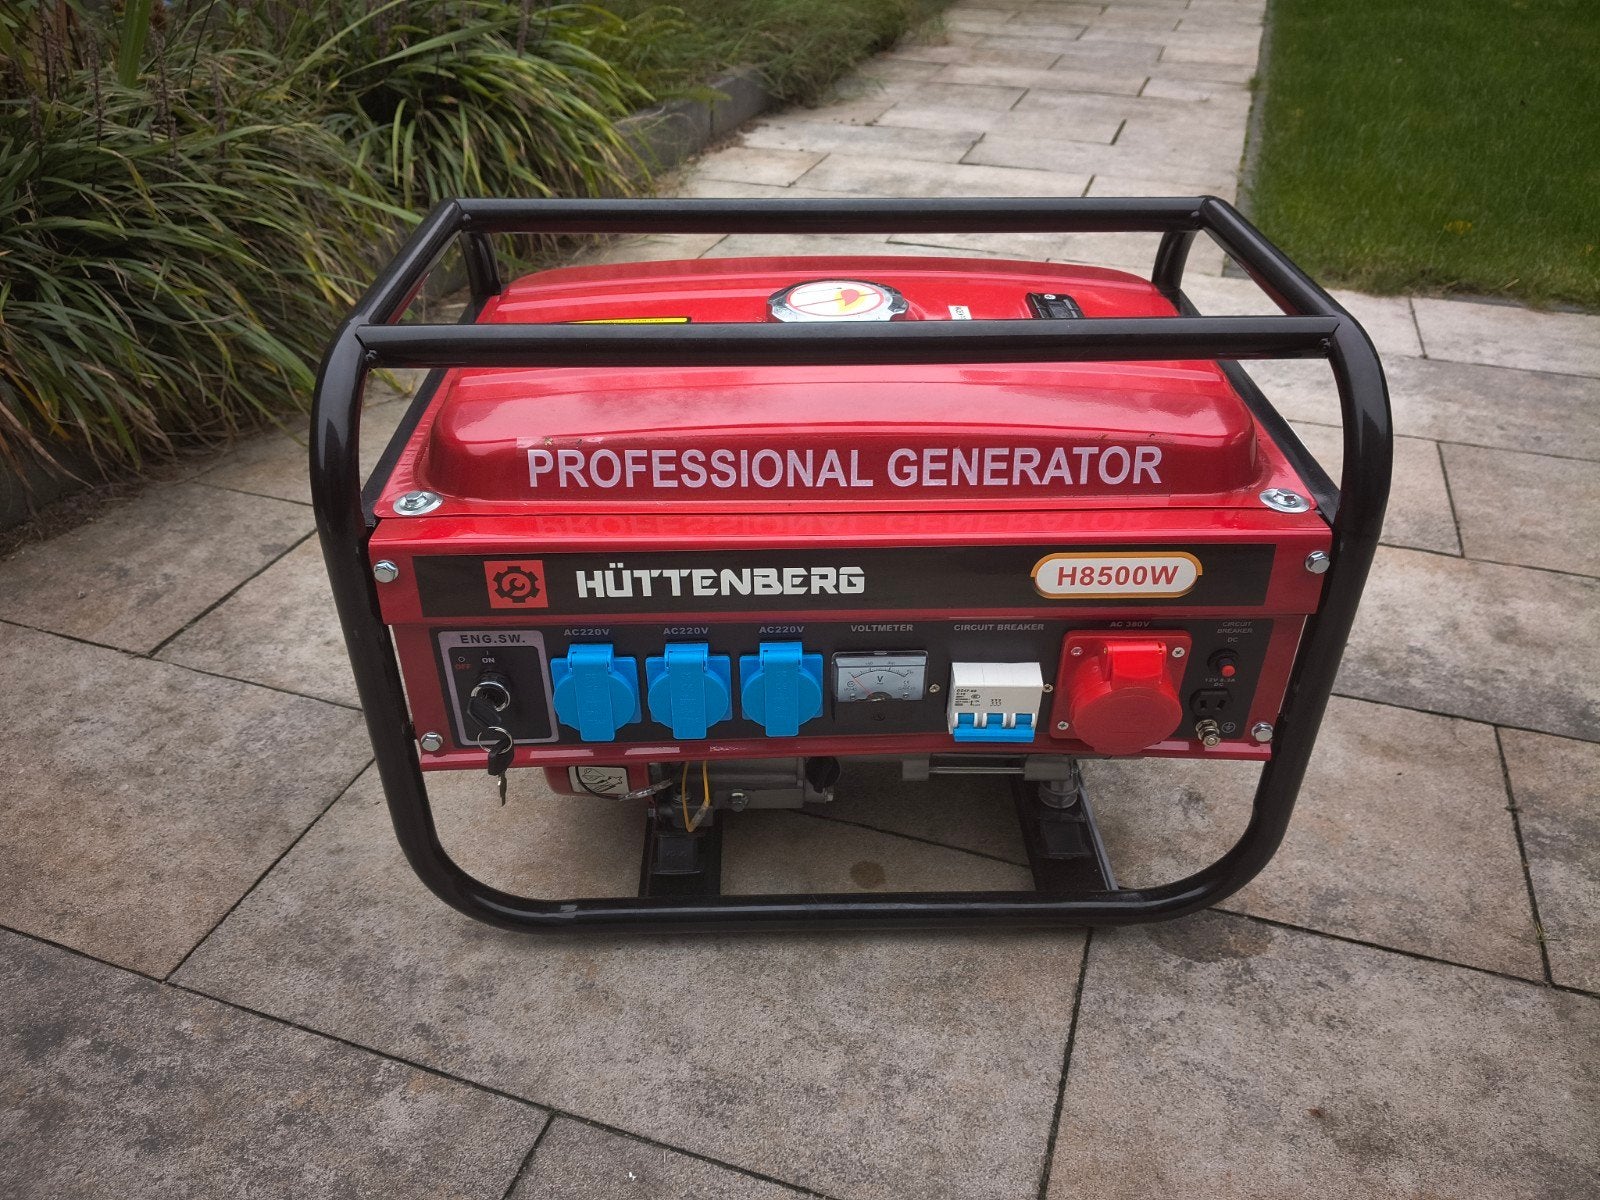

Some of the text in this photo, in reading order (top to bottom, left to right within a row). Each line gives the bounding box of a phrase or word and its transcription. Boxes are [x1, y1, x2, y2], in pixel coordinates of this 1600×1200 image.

[527, 445, 1164, 488] PROFESSIONAL GENERATOR
[576, 562, 866, 597] HÜTTENBERG
[1056, 565, 1180, 587] H8500W
[850, 624, 914, 633] VOLTMETER
[953, 623, 1044, 631] CIRCUIT BREAKER
[1126, 620, 1151, 628] 380V
[564, 628, 610, 636] AC220V
[663, 627, 709, 635] AC220V
[758, 625, 805, 634] AC220V
[460, 633, 526, 644] ENG.SW.
